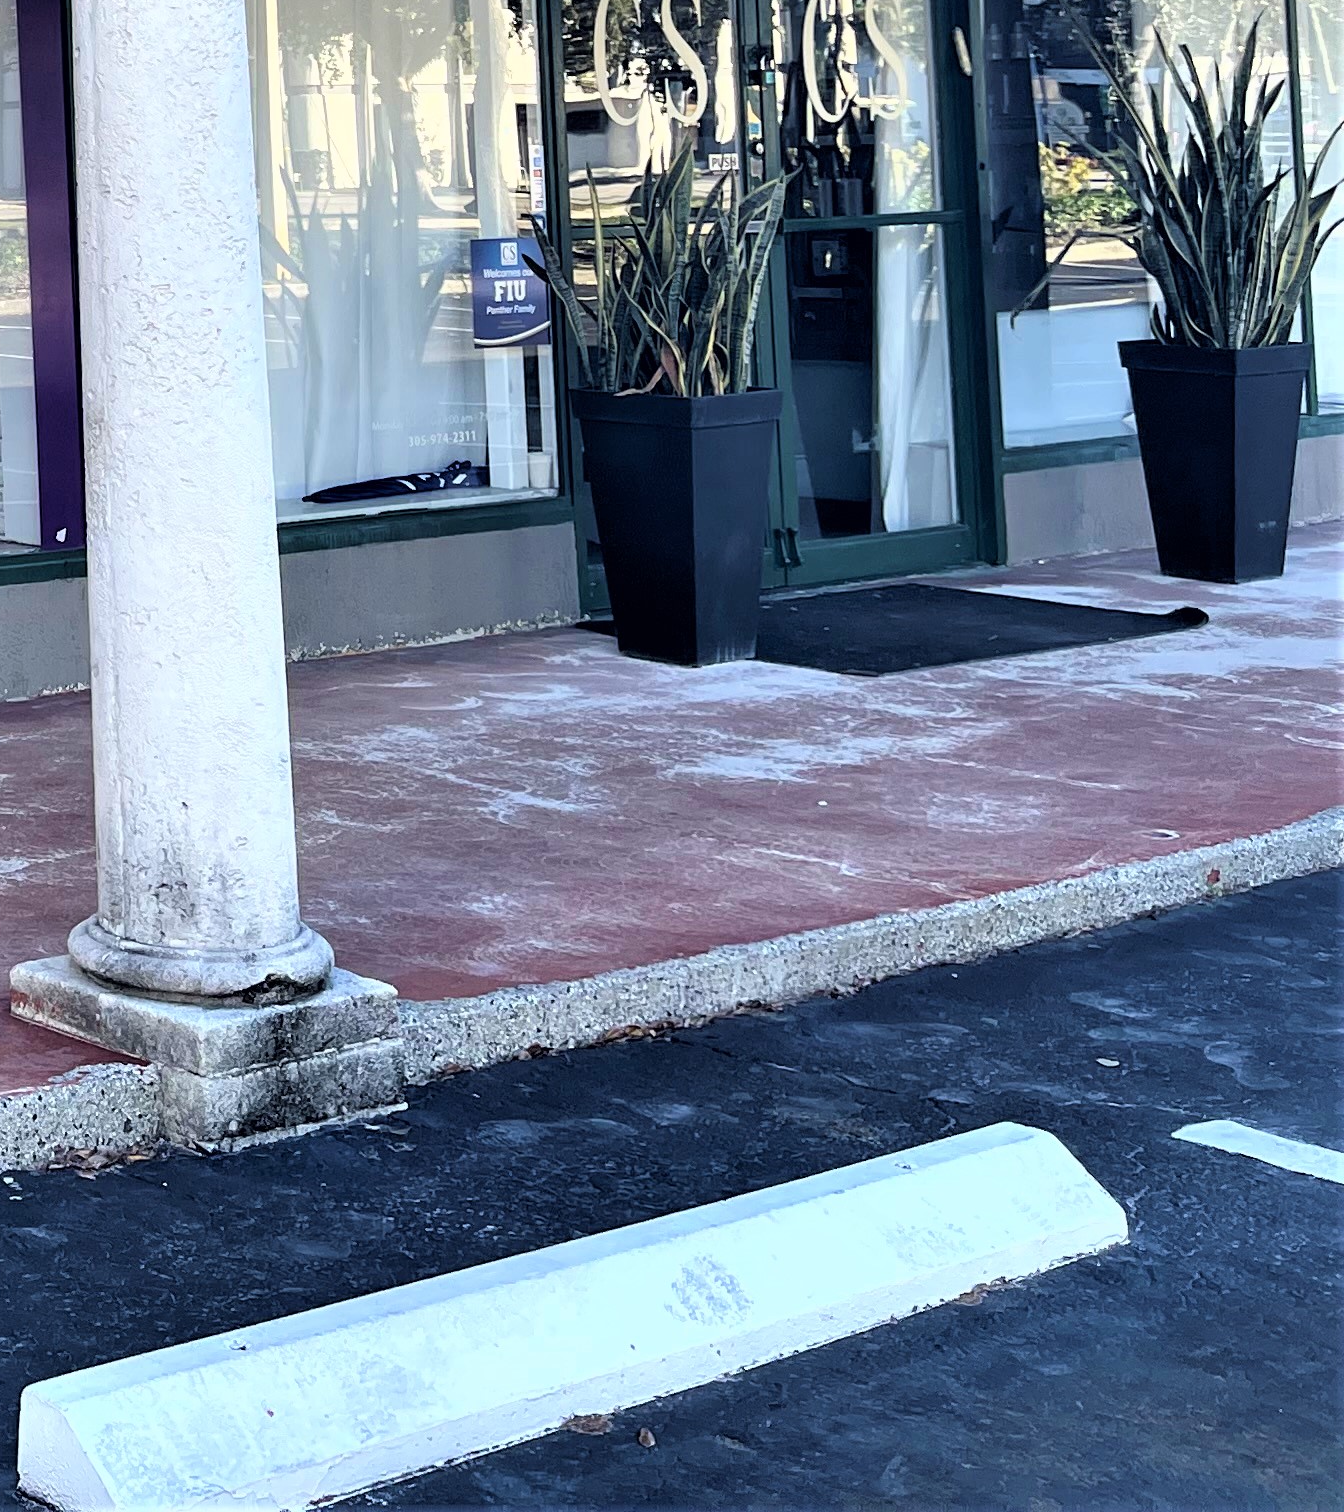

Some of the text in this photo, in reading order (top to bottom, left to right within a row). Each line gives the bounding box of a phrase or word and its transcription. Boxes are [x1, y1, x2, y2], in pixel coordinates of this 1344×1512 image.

[711, 156, 738, 169] PUSH
[503, 246, 517, 261] CS
[483, 269, 521, 279] Welcomes
[494, 280, 526, 302] FIU
[486, 304, 537, 316] Panther Family
